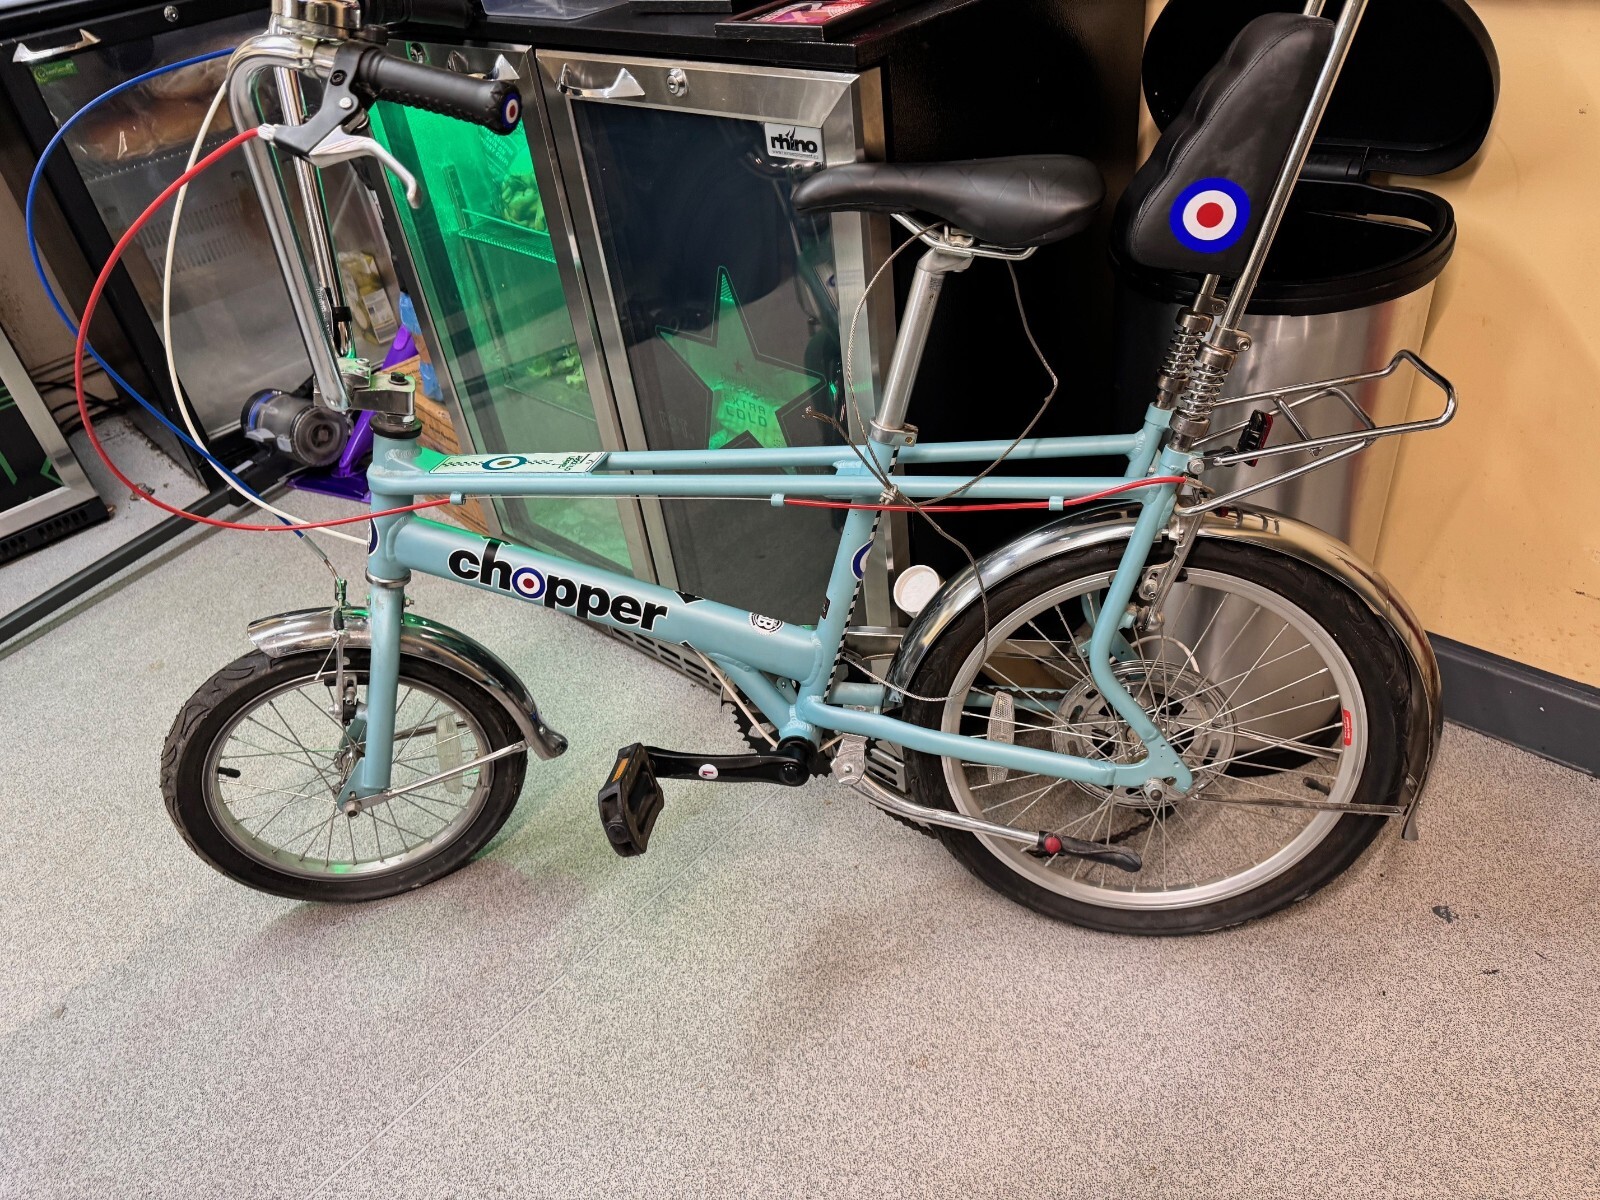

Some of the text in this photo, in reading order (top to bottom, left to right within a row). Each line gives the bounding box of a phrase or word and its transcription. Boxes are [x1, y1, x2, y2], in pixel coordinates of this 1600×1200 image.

[771, 128, 818, 153] rhino
[723, 394, 767, 415] EXTRA
[725, 405, 768, 428] COLD
[448, 536, 668, 632] chopper
